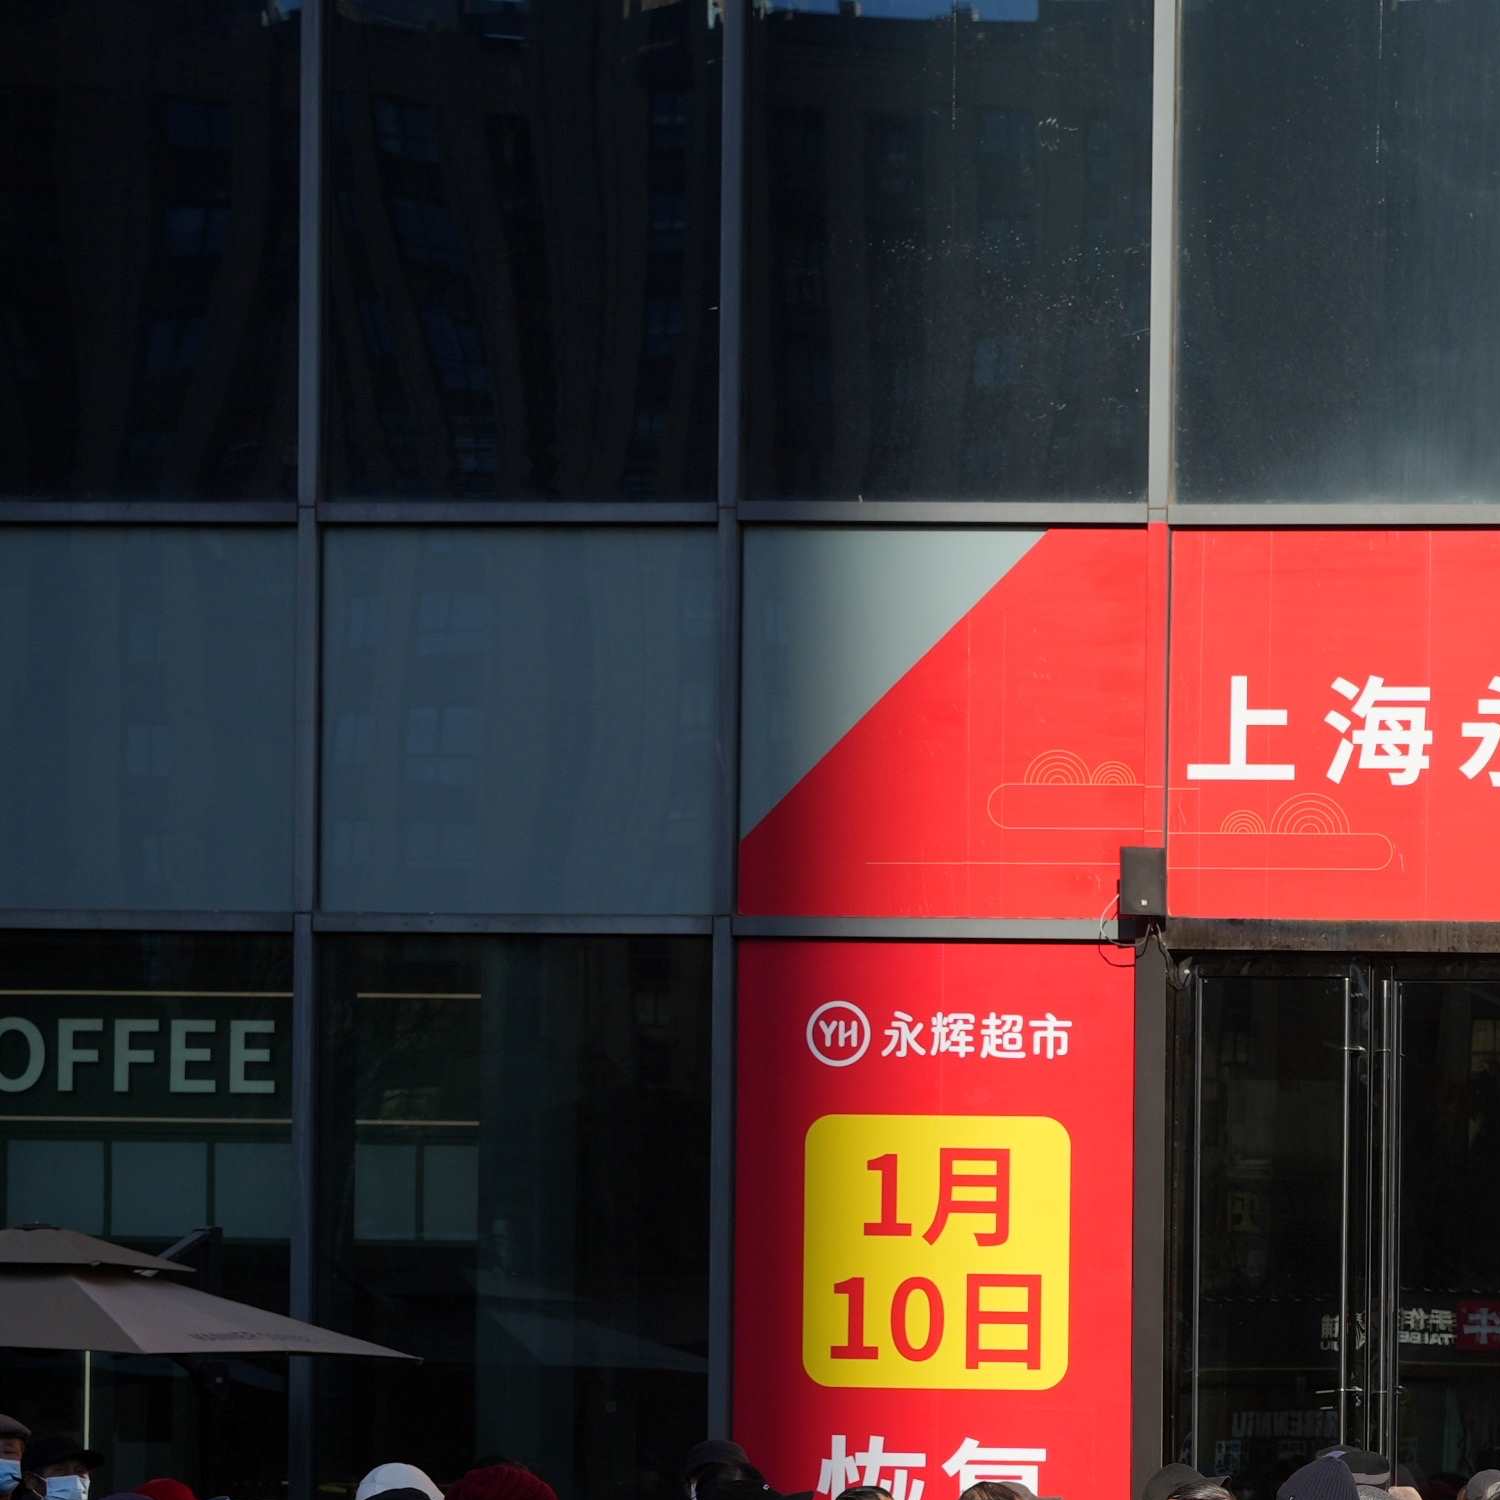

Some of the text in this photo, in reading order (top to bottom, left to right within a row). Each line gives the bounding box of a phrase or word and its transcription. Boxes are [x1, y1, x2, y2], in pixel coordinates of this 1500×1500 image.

[881, 1011, 1073, 1060] 永辉超市
[862, 1147, 1011, 1247] 1月
[829, 1272, 1043, 1371] 10日
